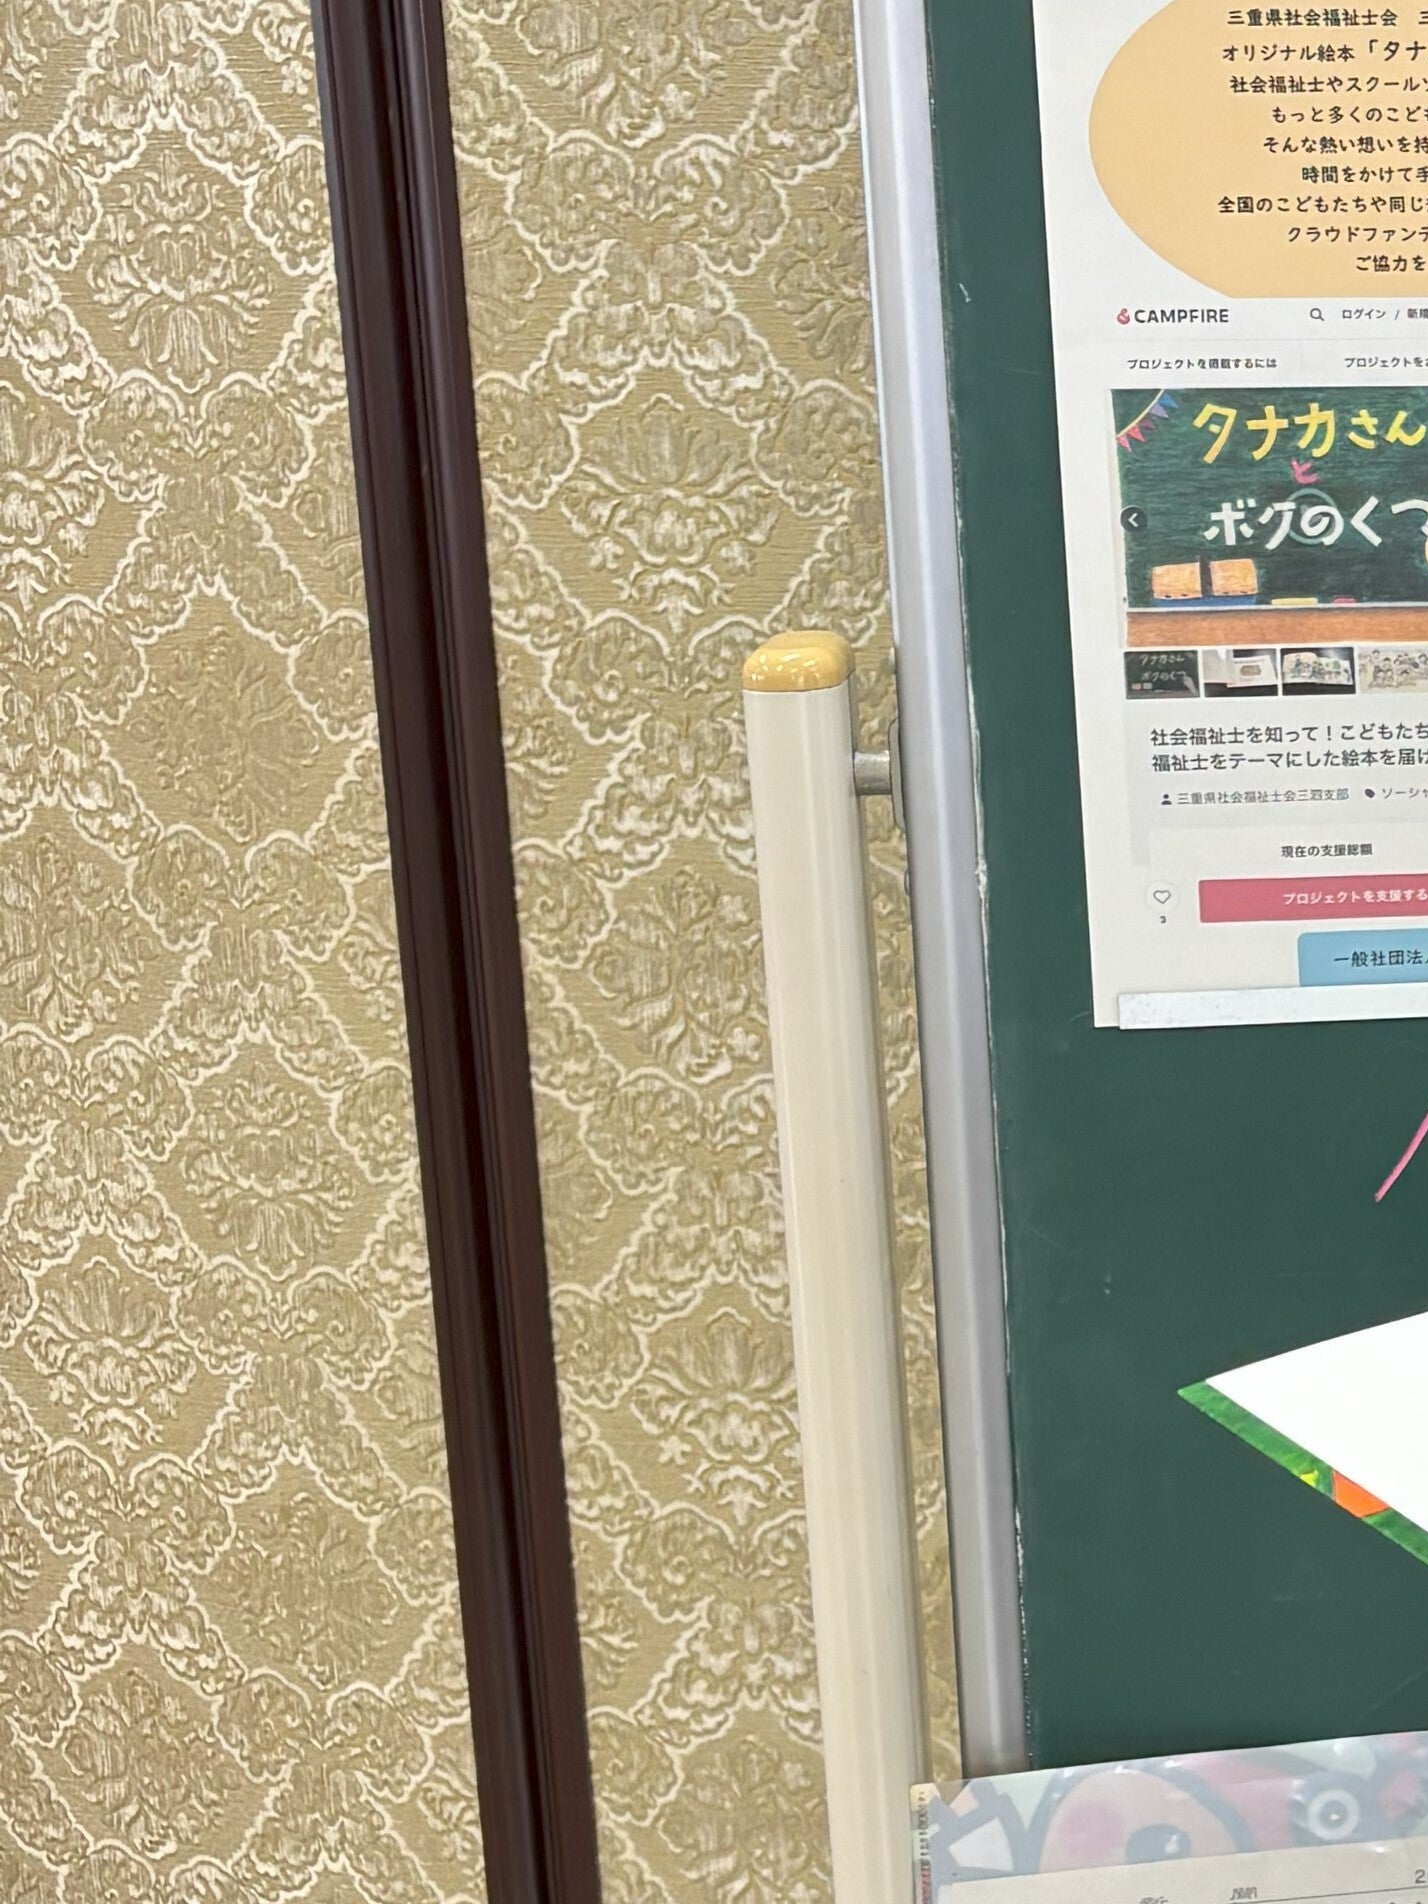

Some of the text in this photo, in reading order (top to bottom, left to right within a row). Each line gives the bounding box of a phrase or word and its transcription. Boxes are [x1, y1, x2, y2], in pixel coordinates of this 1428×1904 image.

[1227, 7, 1399, 27] 三重県社会福祉士会
[1133, 308, 1230, 324] CAMPFIRE
[1342, 308, 1387, 320] ログイン
[1192, 401, 1428, 463] タナカさん
[1289, 458, 1320, 486] と
[1283, 888, 1428, 906] プロジェクトを支援する
